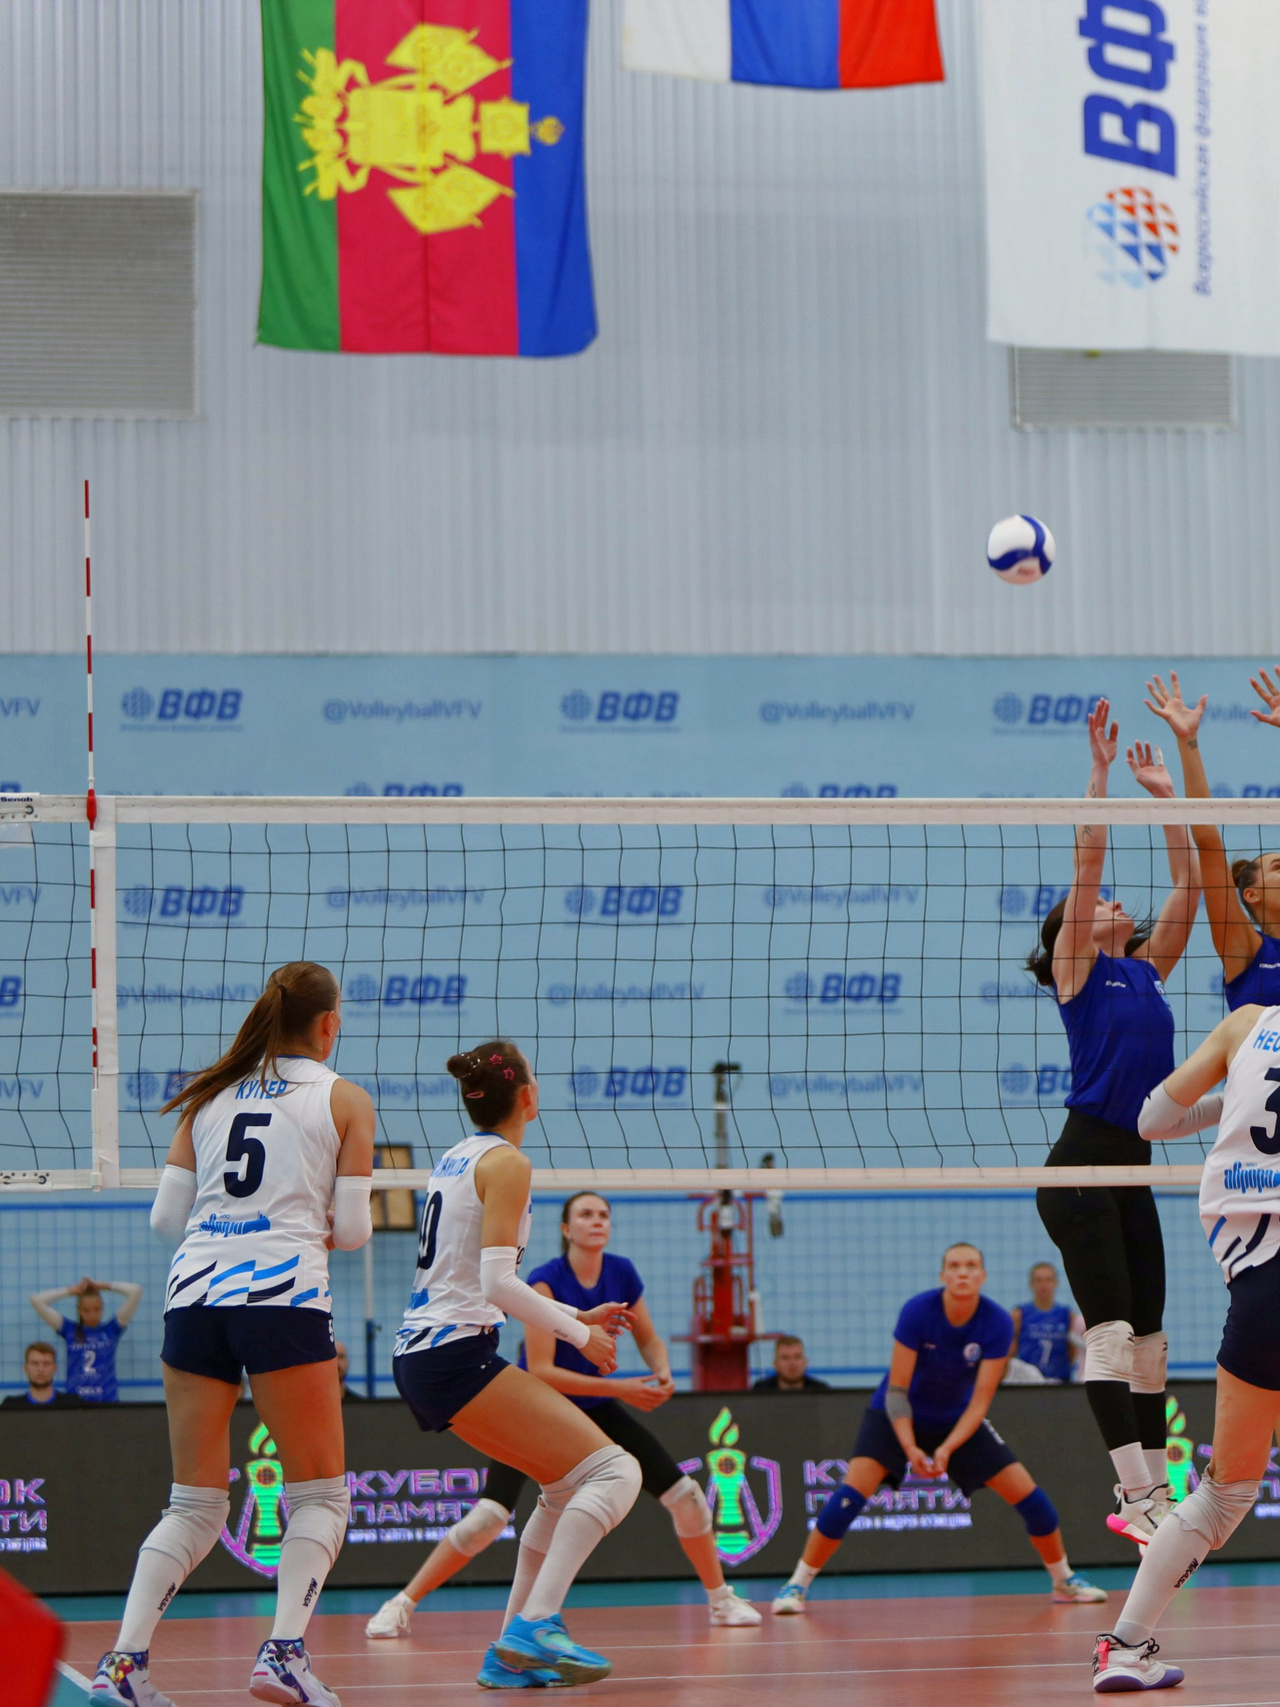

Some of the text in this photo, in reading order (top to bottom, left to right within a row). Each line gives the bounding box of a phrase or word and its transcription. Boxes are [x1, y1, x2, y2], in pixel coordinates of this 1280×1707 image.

[157, 688, 243, 722] ВФВ
[323, 698, 482, 724] @VolleyballVFV
[597, 690, 679, 723] ВФВ
[759, 701, 914, 725] @VolleyballVFV
[160, 885, 245, 918] ВФВ
[326, 885, 485, 909] @VolleyballVFV
[600, 885, 683, 917] ВФВ
[763, 885, 918, 909] @VolleyballVFV
[384, 974, 467, 1006] ВФВ
[547, 981, 705, 1007] @VolleyballVFV
[820, 972, 901, 1004] ВФВ
[235, 1079, 288, 1100] КУПЕР
[605, 1066, 687, 1098] ВФВ
[767, 1073, 924, 1099] @VolleyballVFV
[223, 1112, 272, 1198] 5
[83, 1349, 97, 1374] 2
